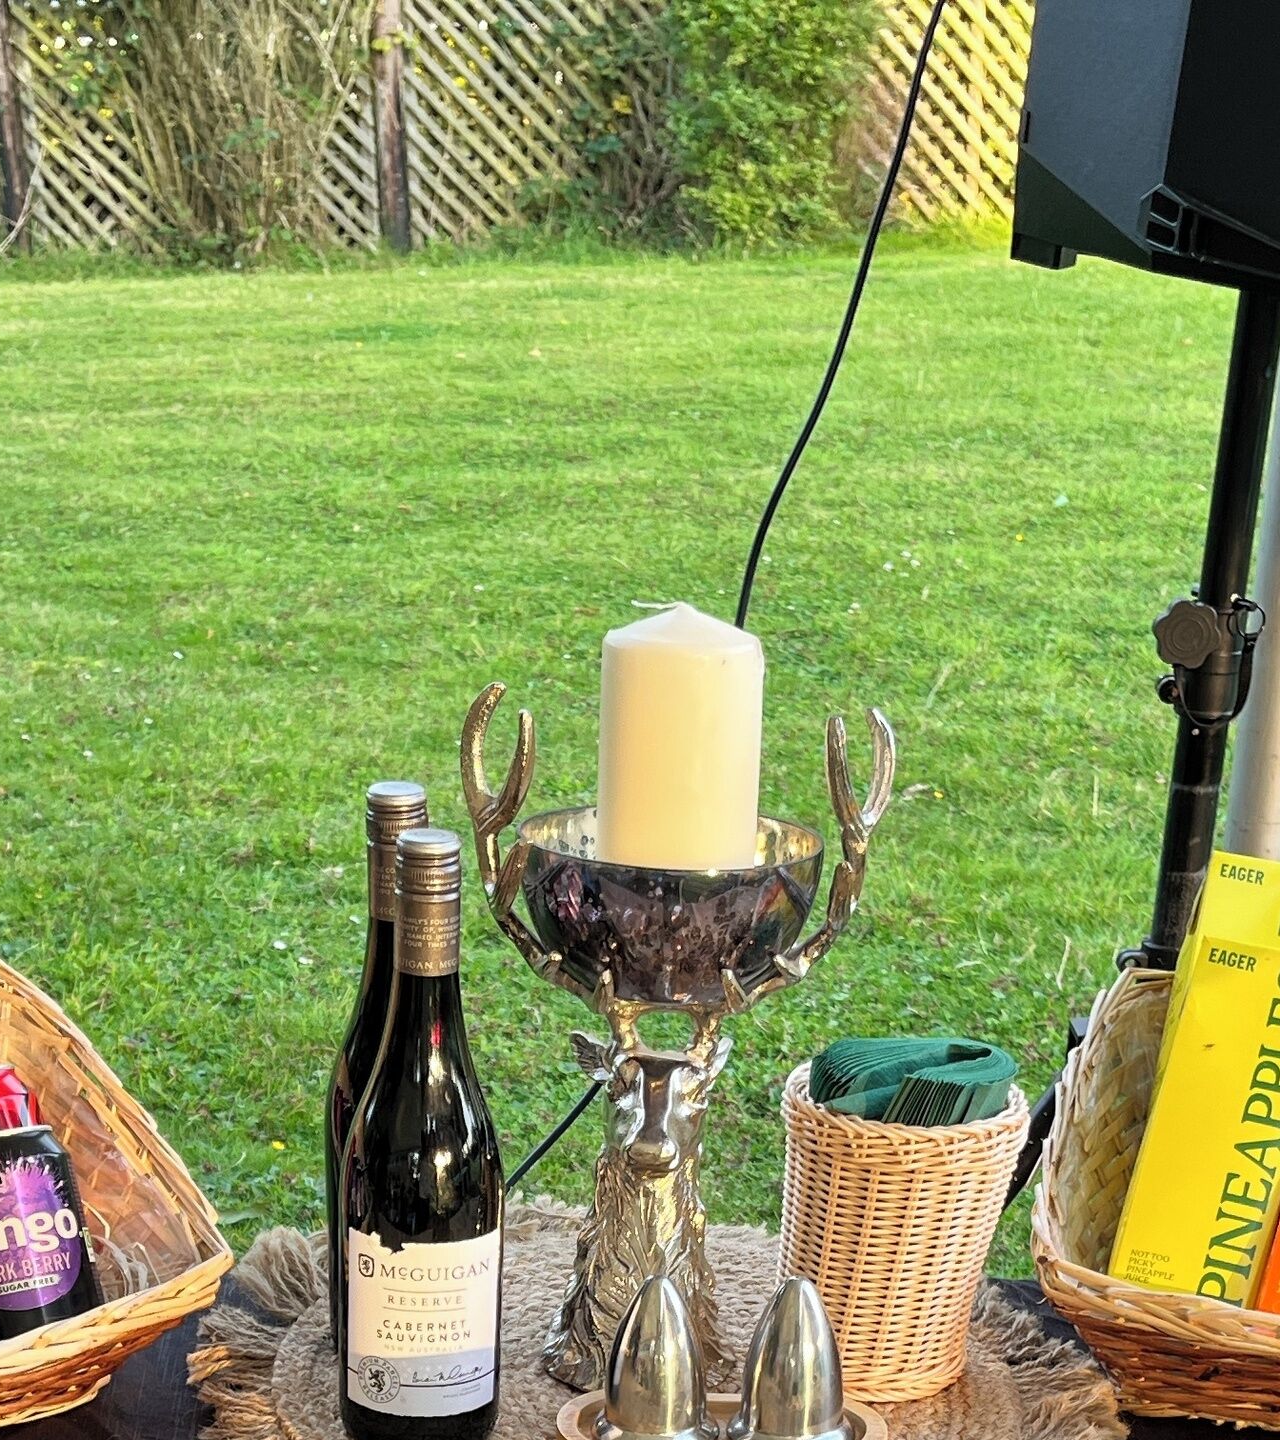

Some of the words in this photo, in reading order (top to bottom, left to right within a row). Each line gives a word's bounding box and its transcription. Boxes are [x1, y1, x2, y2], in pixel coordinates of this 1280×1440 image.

[1220, 863, 1265, 885] EAGER
[1208, 947, 1257, 972] EAGER
[1128, 1256, 1156, 1268] PICKY
[1130, 1249, 1151, 1259] NOT
[1152, 1253, 1170, 1263] TOO
[21, 1252, 71, 1277] BERRY
[379, 1258, 490, 1282] McGUIGAN
[1123, 1273, 1150, 1284] JUICE
[1126, 1265, 1175, 1281] PINEAPPLE
[33, 1276, 55, 1288] FREE
[387, 1294, 463, 1307] RESERVE
[383, 1319, 466, 1332] CABERNET
[376, 1329, 471, 1343] SAUVIGNON
